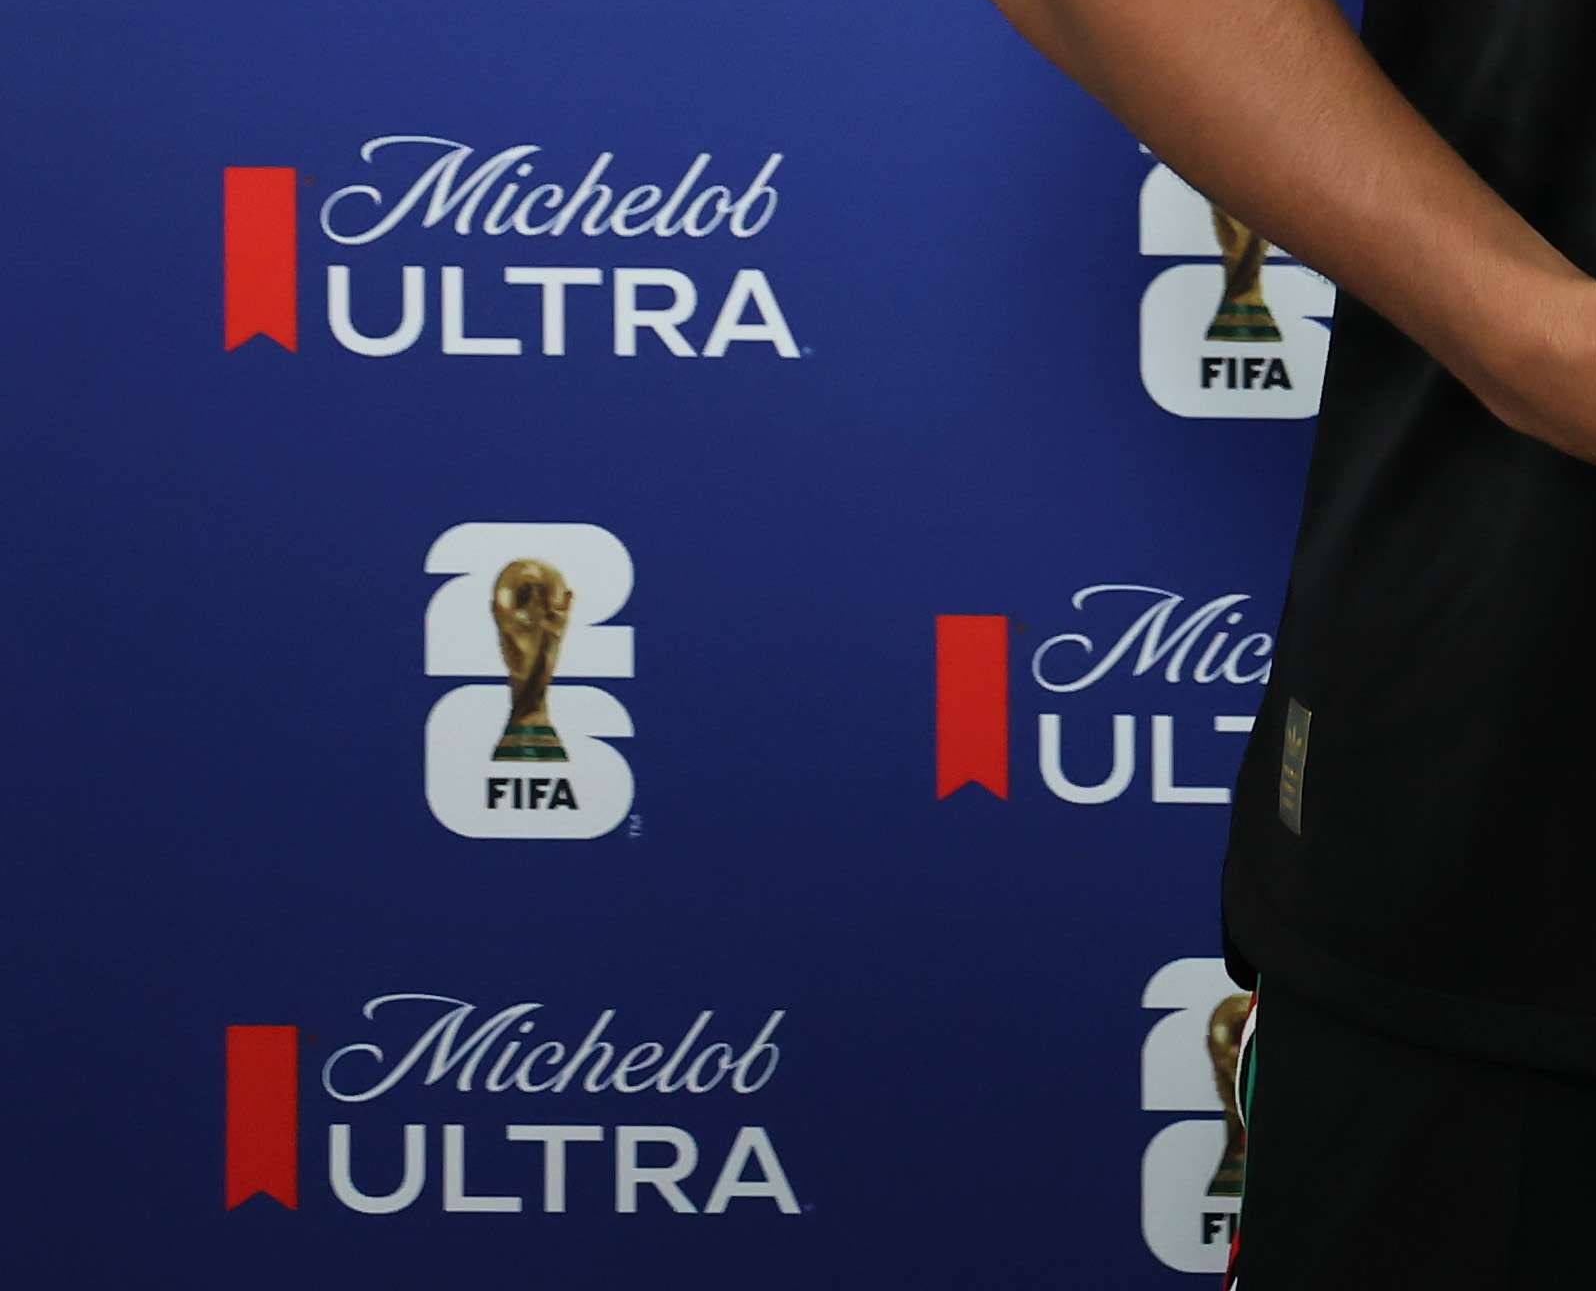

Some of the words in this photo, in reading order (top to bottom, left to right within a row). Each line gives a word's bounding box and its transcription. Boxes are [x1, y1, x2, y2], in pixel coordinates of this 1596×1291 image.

[320, 136, 784, 245] Michelob
[327, 265, 801, 358] ULTRA
[1201, 357, 1293, 390] FIFA
[488, 778, 578, 810] FIFA
[322, 994, 785, 1102] Michelob
[329, 1124, 801, 1214] ULTRA
[1202, 1212, 1238, 1245] FI
